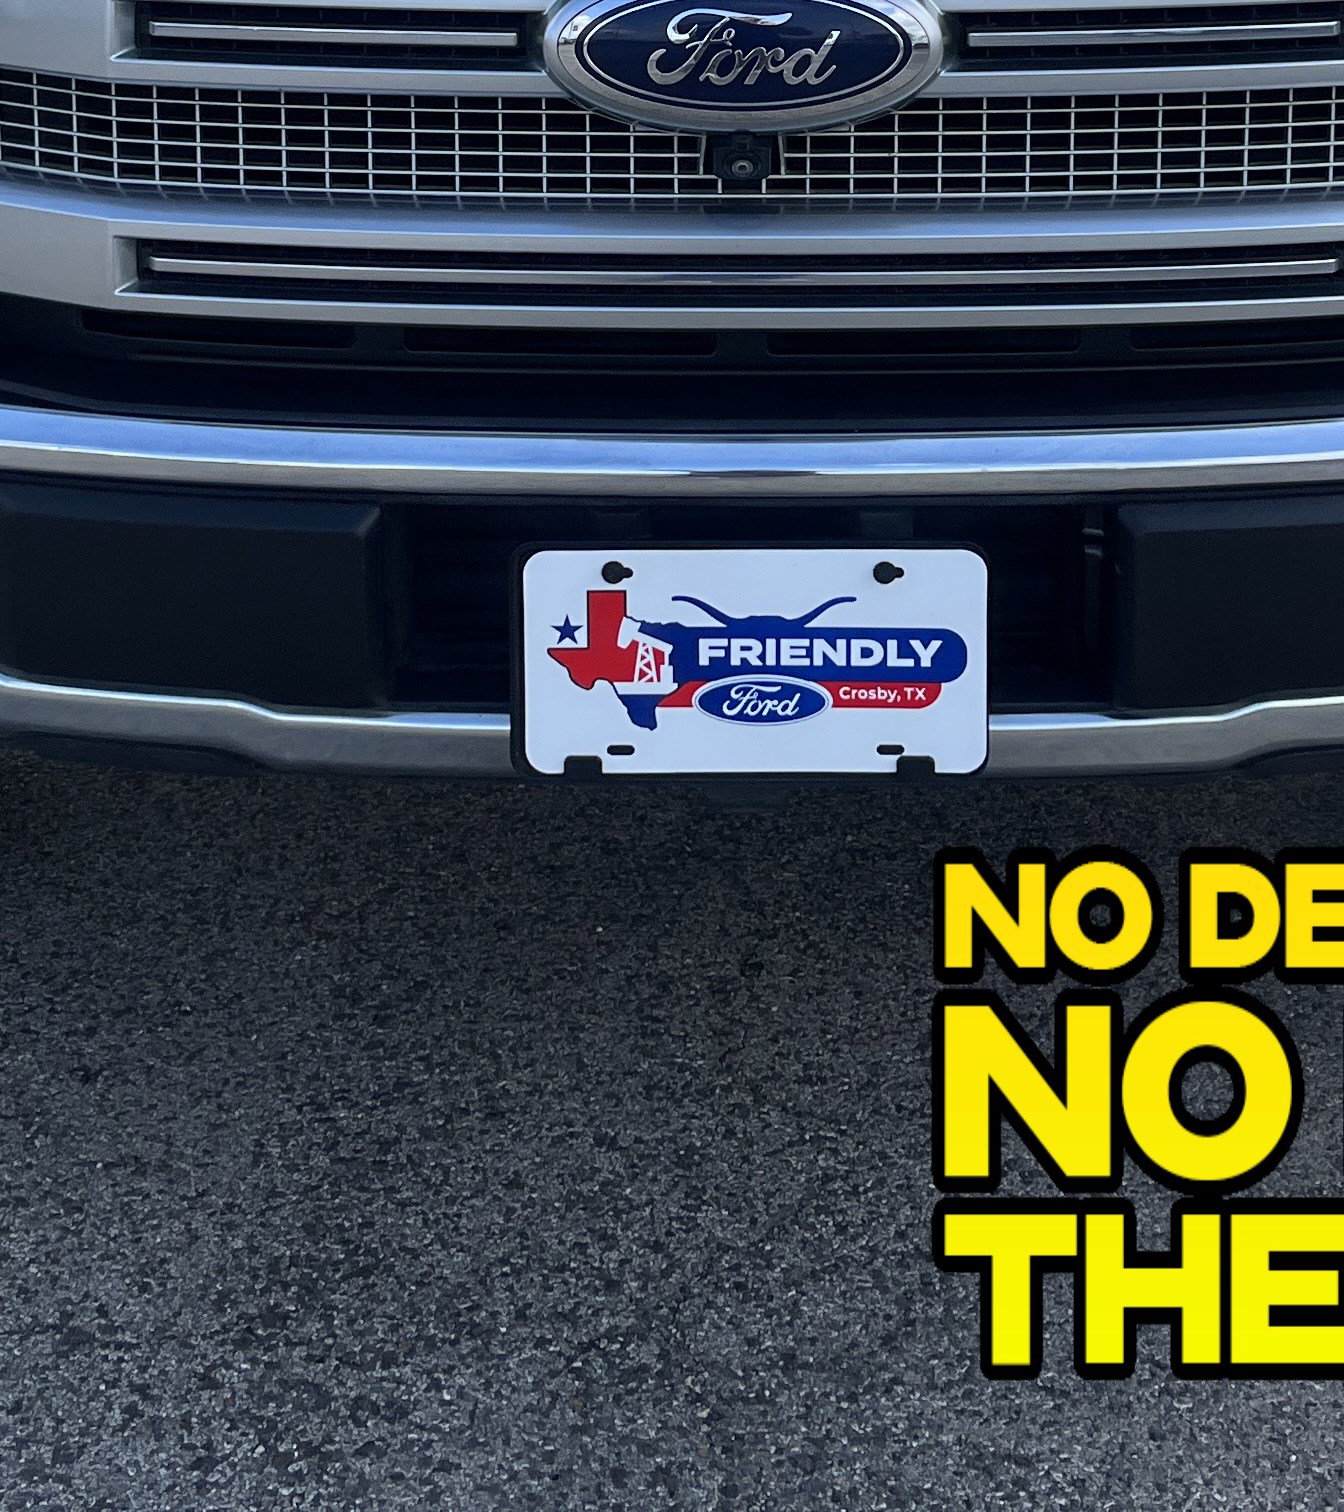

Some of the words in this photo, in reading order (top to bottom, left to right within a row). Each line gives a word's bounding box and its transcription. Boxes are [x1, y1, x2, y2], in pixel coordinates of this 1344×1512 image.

[645, 6, 838, 87] Ford
[698, 638, 943, 668] FRIENDLY
[722, 683, 800, 717] Ford
[838, 686, 902, 703] Crosby,
[903, 686, 927, 702] TX
